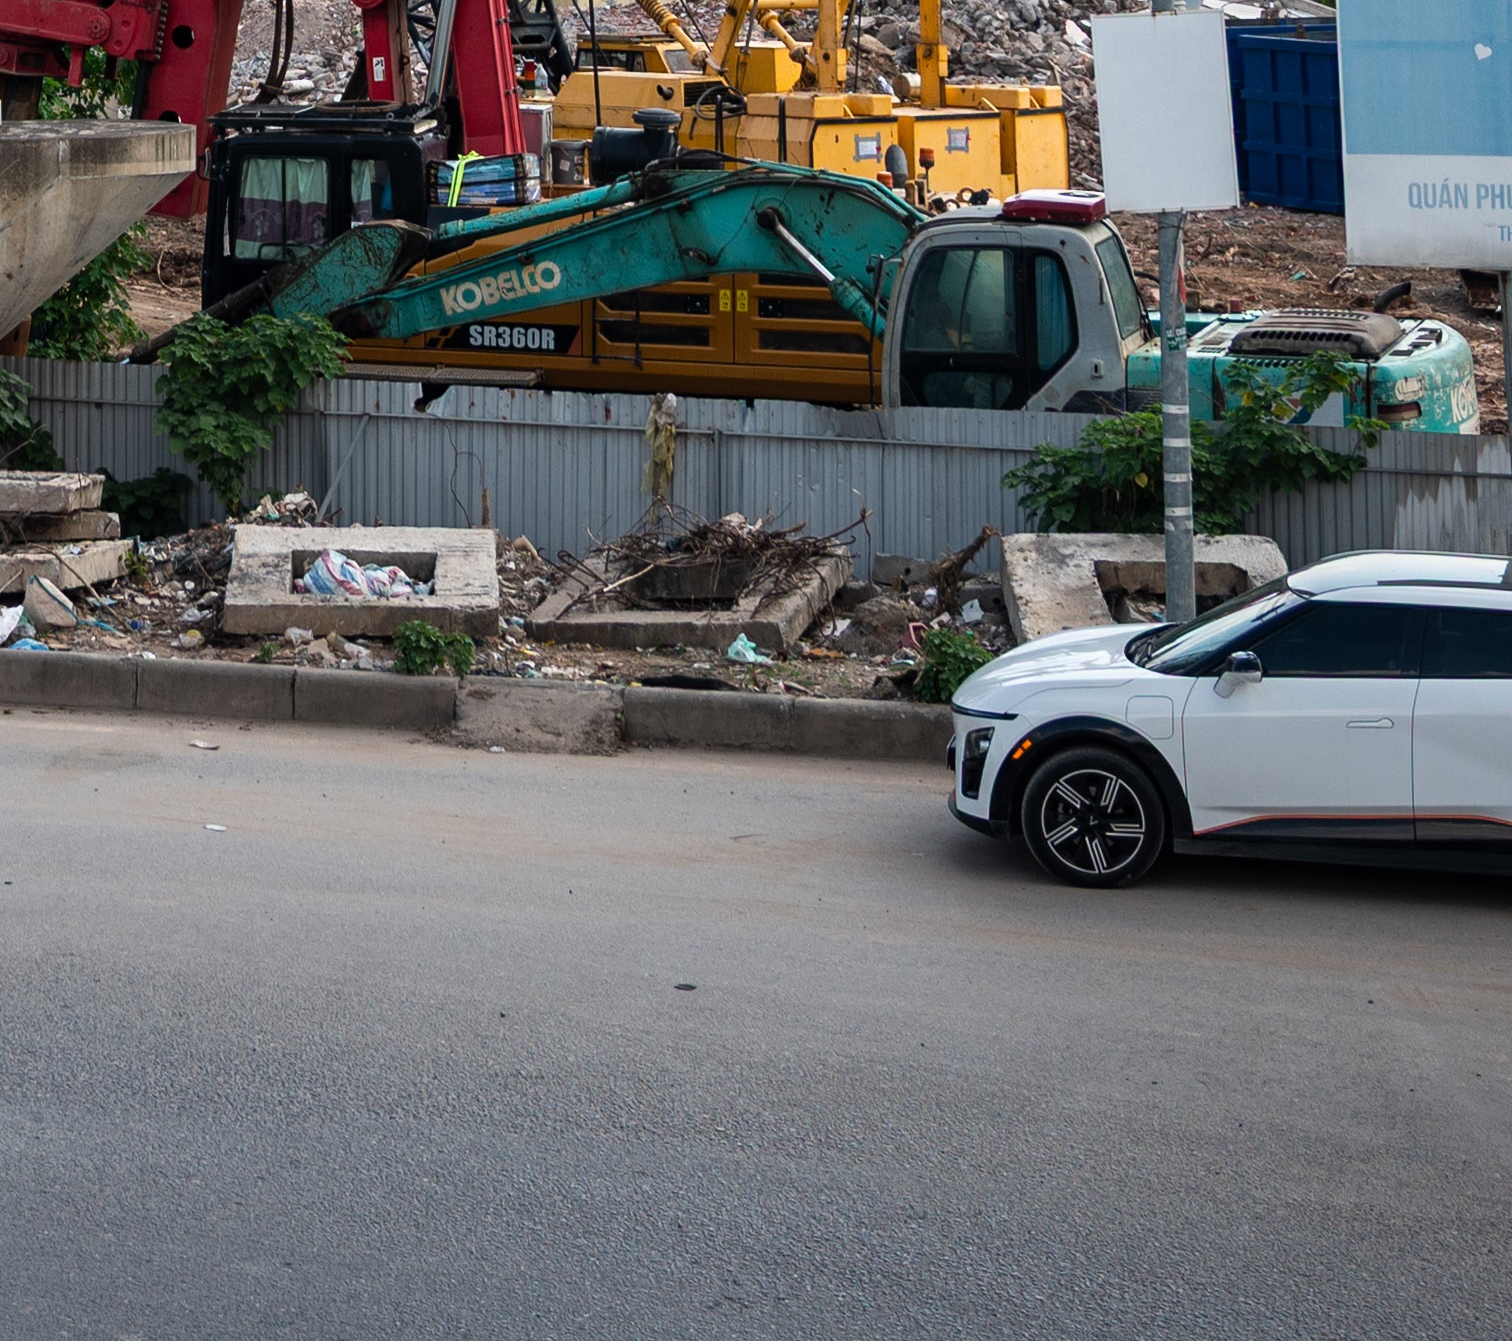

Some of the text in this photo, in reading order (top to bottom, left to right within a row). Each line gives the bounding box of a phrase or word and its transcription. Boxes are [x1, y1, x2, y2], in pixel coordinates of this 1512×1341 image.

[1407, 177, 1469, 210] QUÁN
[440, 260, 562, 316] KOBELCO
[469, 324, 555, 350] SR360R
